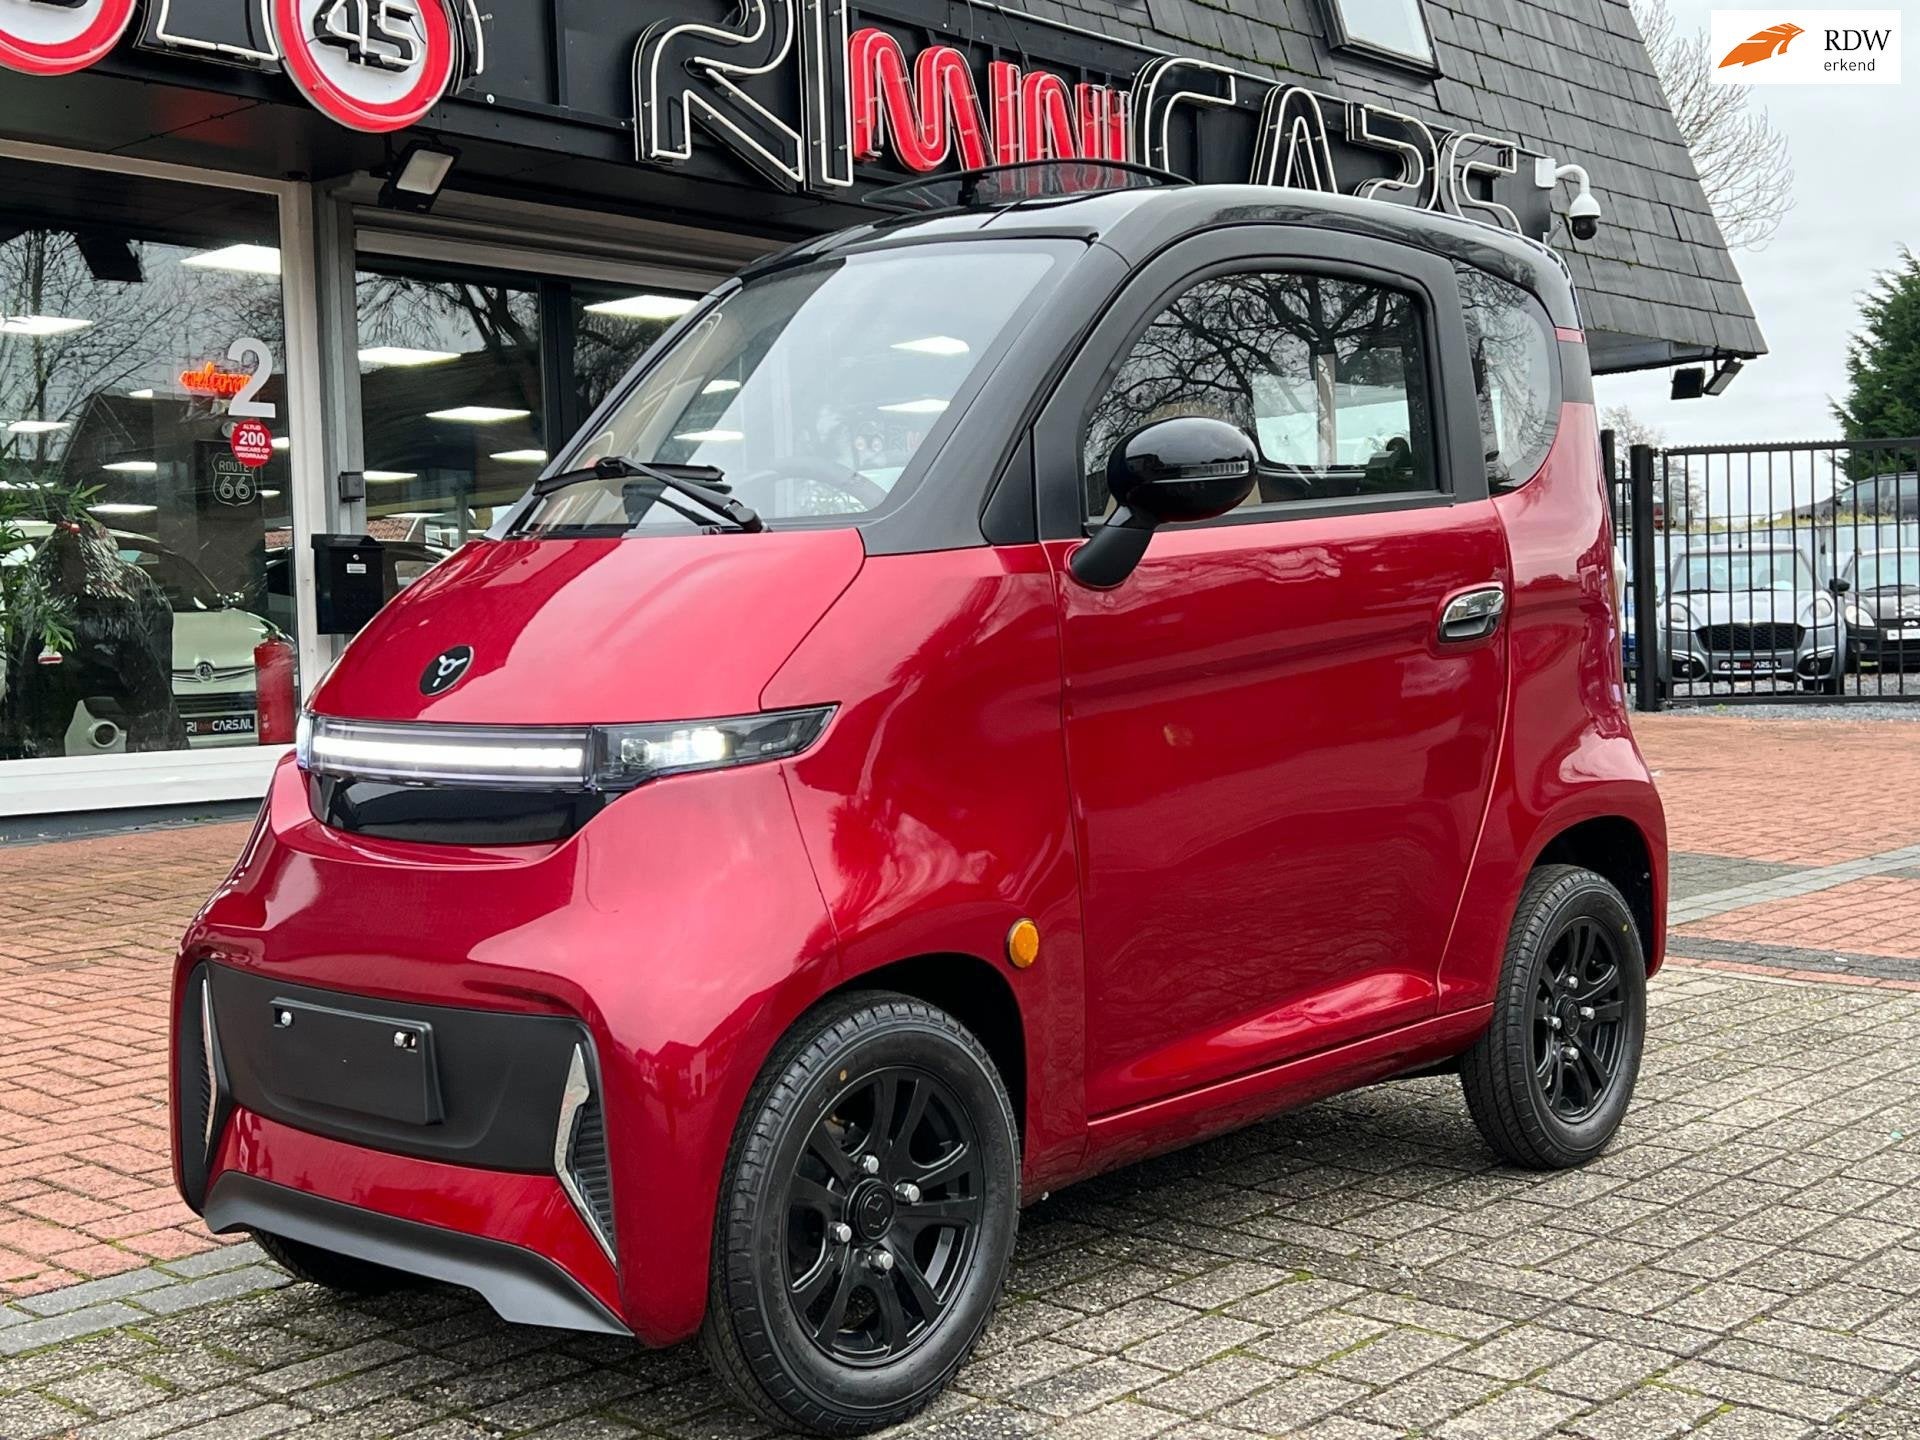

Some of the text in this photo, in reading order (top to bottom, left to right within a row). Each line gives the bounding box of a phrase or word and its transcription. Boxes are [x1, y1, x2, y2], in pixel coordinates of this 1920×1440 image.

[313, 0, 420, 73] 45
[227, 337, 276, 418] 2
[239, 431, 266, 447] 200
[218, 460, 250, 473] ROUTE
[220, 475, 251, 499] 66
